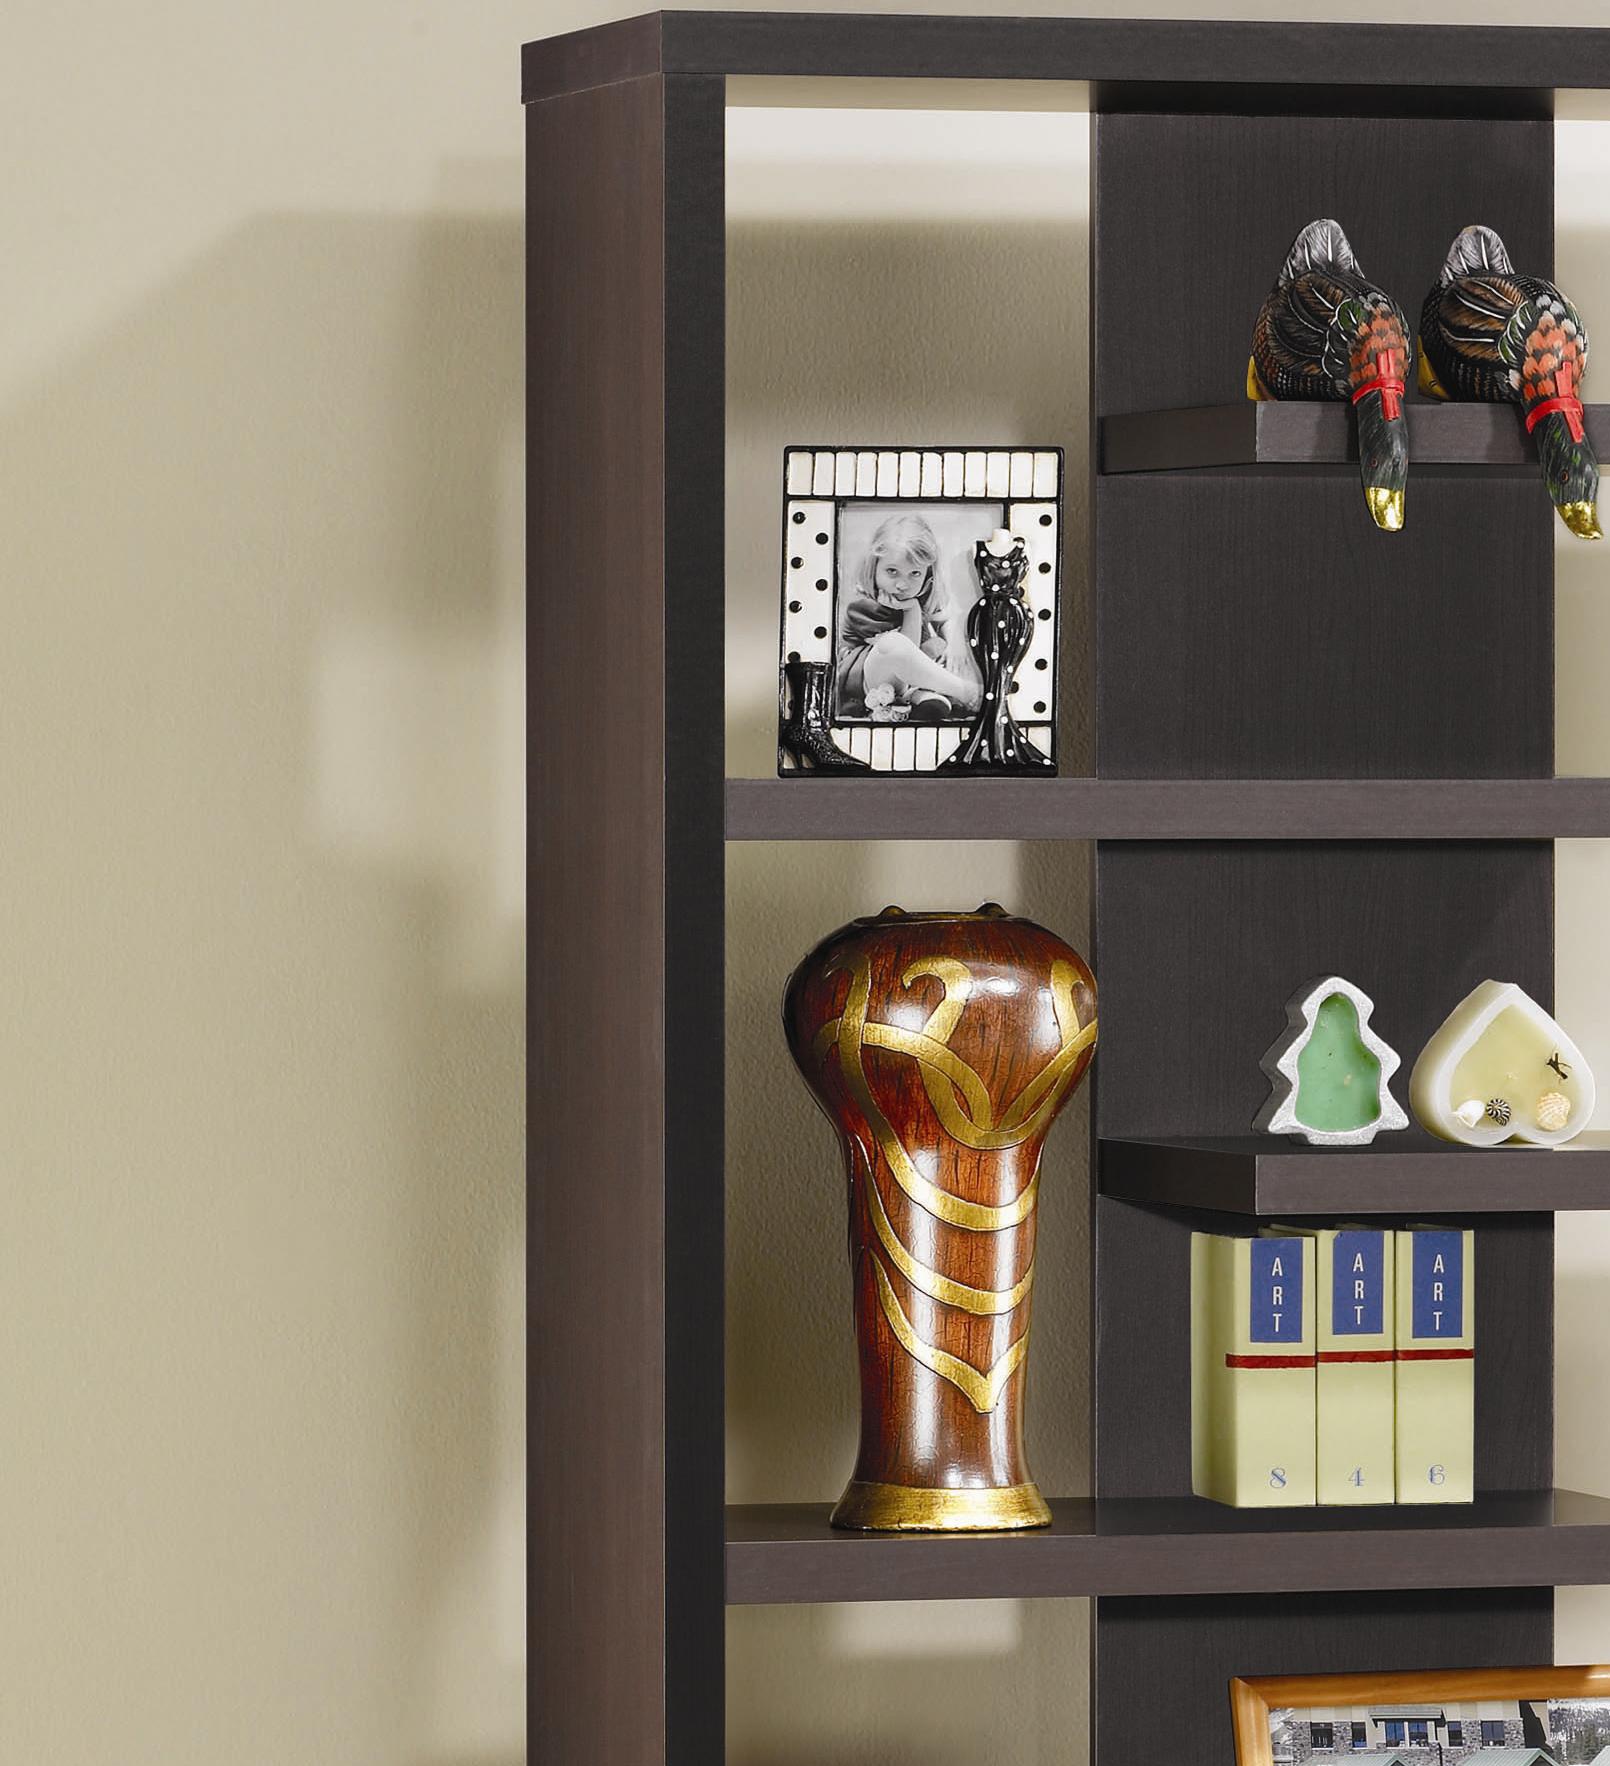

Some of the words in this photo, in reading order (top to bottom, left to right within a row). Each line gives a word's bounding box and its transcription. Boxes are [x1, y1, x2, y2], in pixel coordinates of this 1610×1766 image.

[1271, 1256, 1284, 1333] ART
[1352, 1252, 1365, 1326] ART
[1432, 1253, 1445, 1332] ART
[1268, 1467, 1288, 1489] 8
[1347, 1466, 1366, 1488] 4
[1428, 1464, 1446, 1486] 6
